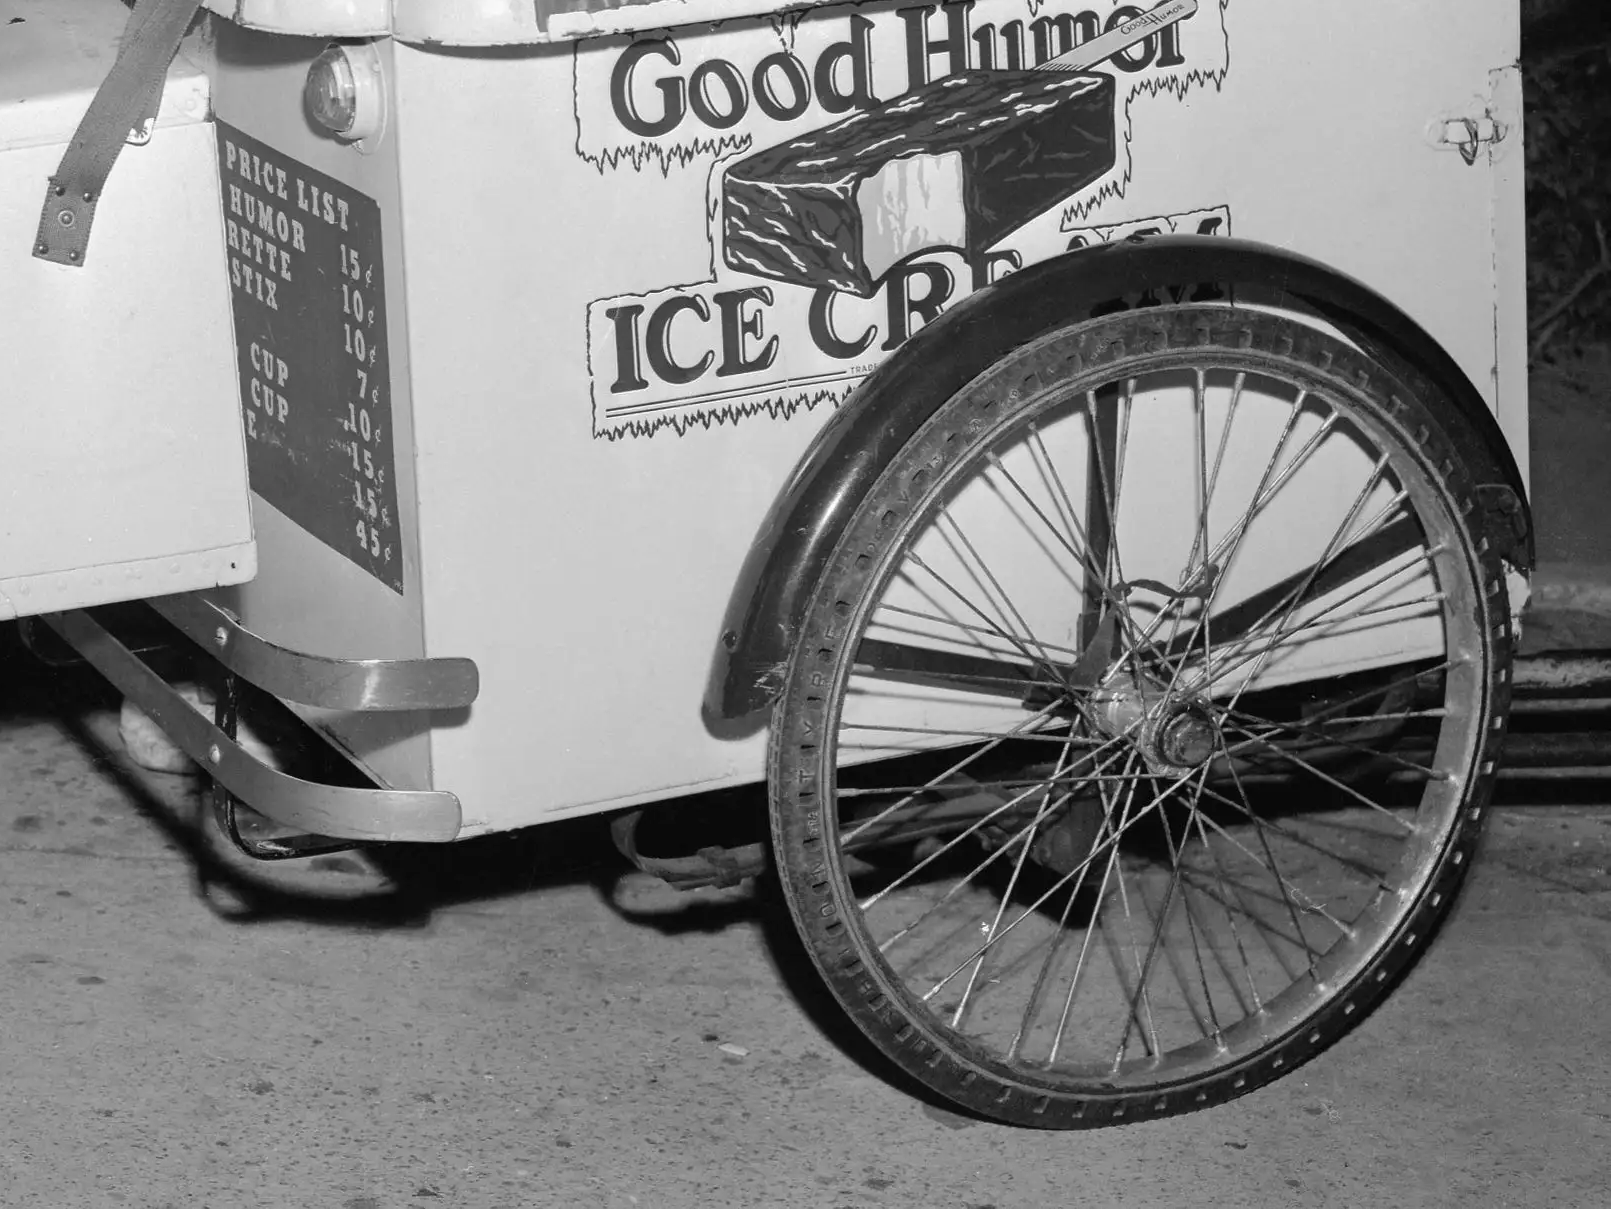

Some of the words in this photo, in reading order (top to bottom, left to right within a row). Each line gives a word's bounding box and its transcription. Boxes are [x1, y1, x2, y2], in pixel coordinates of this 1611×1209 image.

[609, 14, 882, 137] Good
[226, 140, 288, 200] PRICE
[296, 178, 349, 232] LIST
[229, 184, 306, 253] HUMOR
[231, 258, 278, 311] STIX
[250, 342, 289, 388] CUP
[605, 284, 780, 394] ICE
[250, 378, 289, 424] CUP
